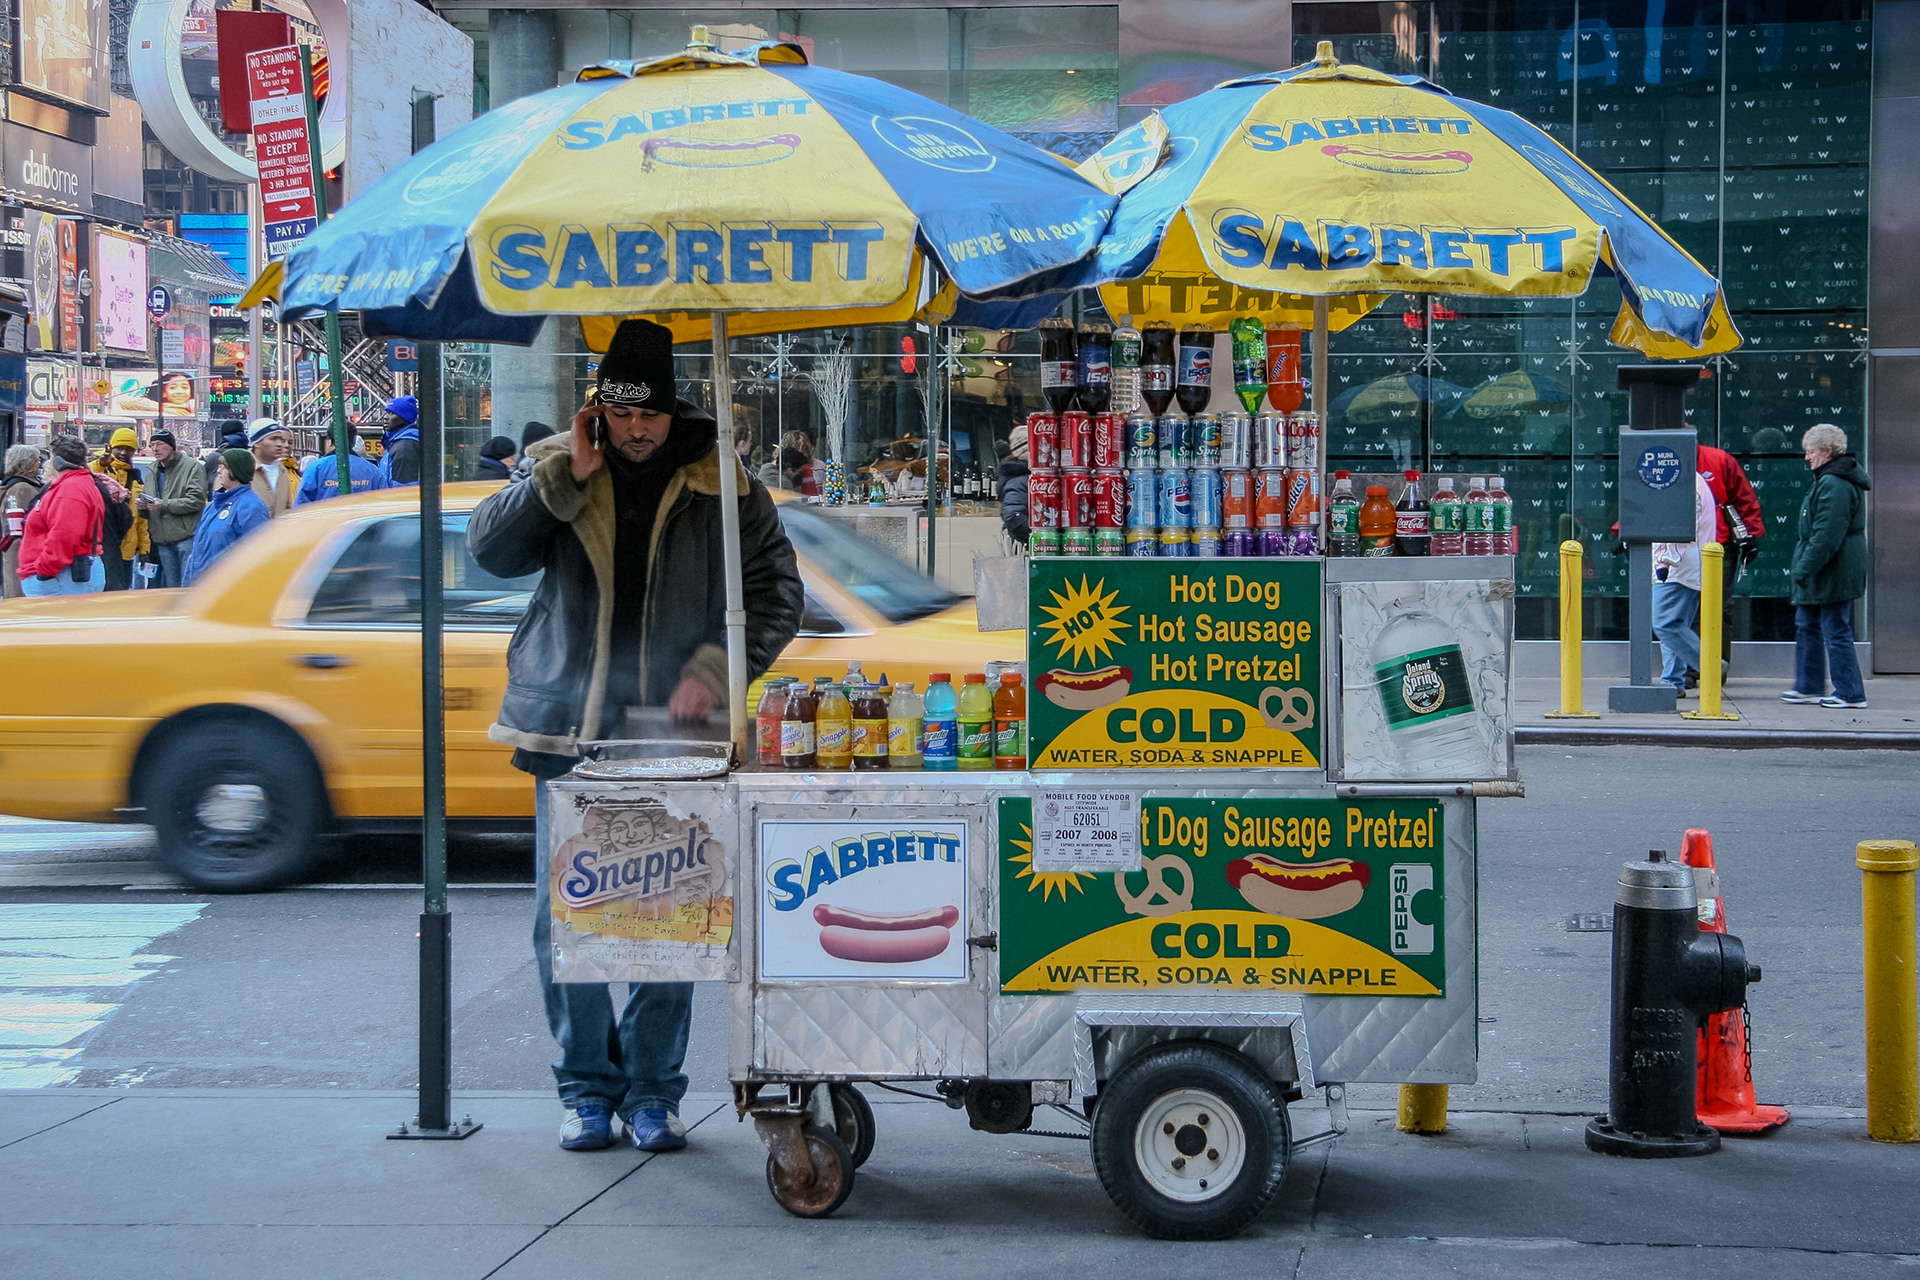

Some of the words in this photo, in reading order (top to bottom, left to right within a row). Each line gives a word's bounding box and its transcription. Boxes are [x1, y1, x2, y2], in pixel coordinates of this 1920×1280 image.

[250, 57, 260, 68] NO
[263, 51, 296, 66] STANDING
[262, 80, 271, 88] WED
[258, 108, 278, 118] OTHER
[281, 104, 299, 114] TIMES
[257, 134, 268, 144] NO
[270, 127, 305, 142] STANDING
[558, 98, 813, 151] SABRETT
[1243, 115, 1472, 151] SABRETT
[266, 142, 297, 157] EXCEPT
[259, 157, 286, 169] COMMERCIAL
[288, 154, 309, 164] VEHICLES
[261, 168, 285, 180] METERED
[286, 164, 309, 176] PARKING
[269, 181, 274, 190] 3
[276, 179, 285, 188] HR
[286, 177, 303, 187] LIMIT
[275, 225, 292, 238] PAY
[296, 224, 306, 234] AT
[947, 232, 1007, 263] WE'RE
[1009, 227, 1036, 243] ON
[1035, 227, 1051, 241] A
[1048, 215, 1098, 239] ROLL
[1211, 207, 1576, 276] SABRETT
[489, 220, 884, 291] SABRETT
[1271, 352, 1288, 379] Sunkist
[1396, 518, 1425, 529] Coca-Cola
[1170, 574, 1217, 603] Hot
[1225, 574, 1281, 610] Dog
[1062, 601, 1106, 640] HOT
[1138, 614, 1186, 642] Hot
[1195, 613, 1312, 650] Sausage
[1151, 653, 1198, 682] Hot
[1206, 653, 1301, 682] Pretzel
[1405, 660, 1431, 677] Poland
[1403, 671, 1440, 696] Spring
[820, 728, 848, 744] Snapple
[1105, 707, 1246, 744] COLD
[1050, 749, 1123, 765] WATER,
[1130, 749, 1185, 763] SODA
[1191, 749, 1208, 763] &
[1214, 749, 1303, 763] SNAPPLE
[1073, 812, 1101, 826] 62051
[1055, 830, 1082, 840] 2007
[1091, 830, 1118, 840] 2008
[1158, 808, 1208, 857] Dog
[1224, 806, 1332, 858] Sausage
[1347, 807, 1435, 850] Pretzel
[766, 830, 960, 912] SABRETT
[1394, 868, 1409, 949] PEPSI
[1151, 923, 1291, 959] COLD
[1047, 965, 1148, 987] WATER,
[1157, 966, 1234, 986] SODA
[1243, 967, 1262, 986] &
[1271, 966, 1397, 986] SNAPPLE
